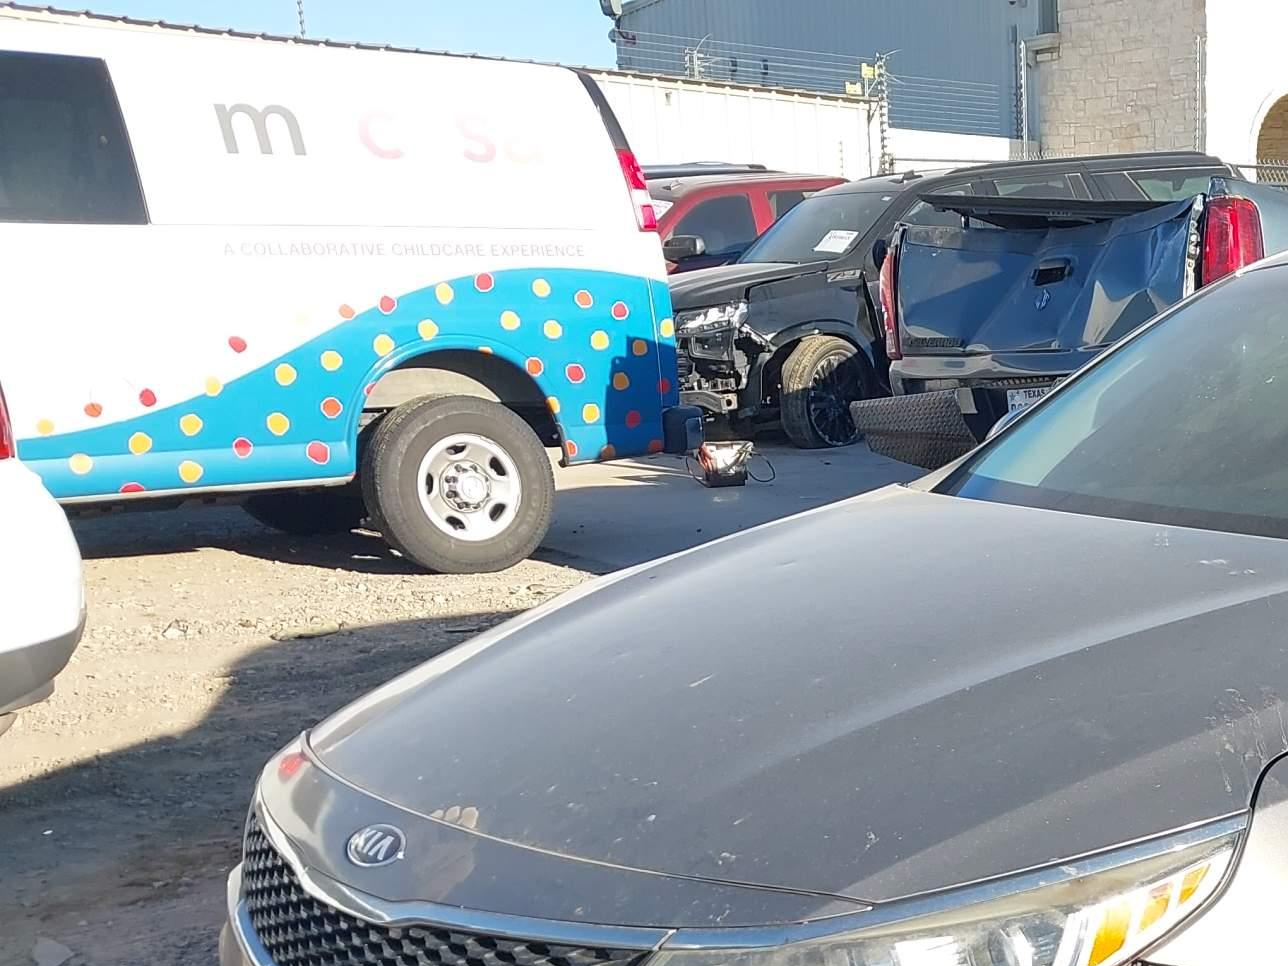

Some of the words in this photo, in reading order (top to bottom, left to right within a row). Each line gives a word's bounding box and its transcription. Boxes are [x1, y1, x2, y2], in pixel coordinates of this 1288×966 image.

[224, 243, 235, 256] A
[240, 243, 386, 257] COLLABORATIVE
[391, 244, 487, 257] CHILDCARE
[491, 244, 585, 257] EXPERIENCE
